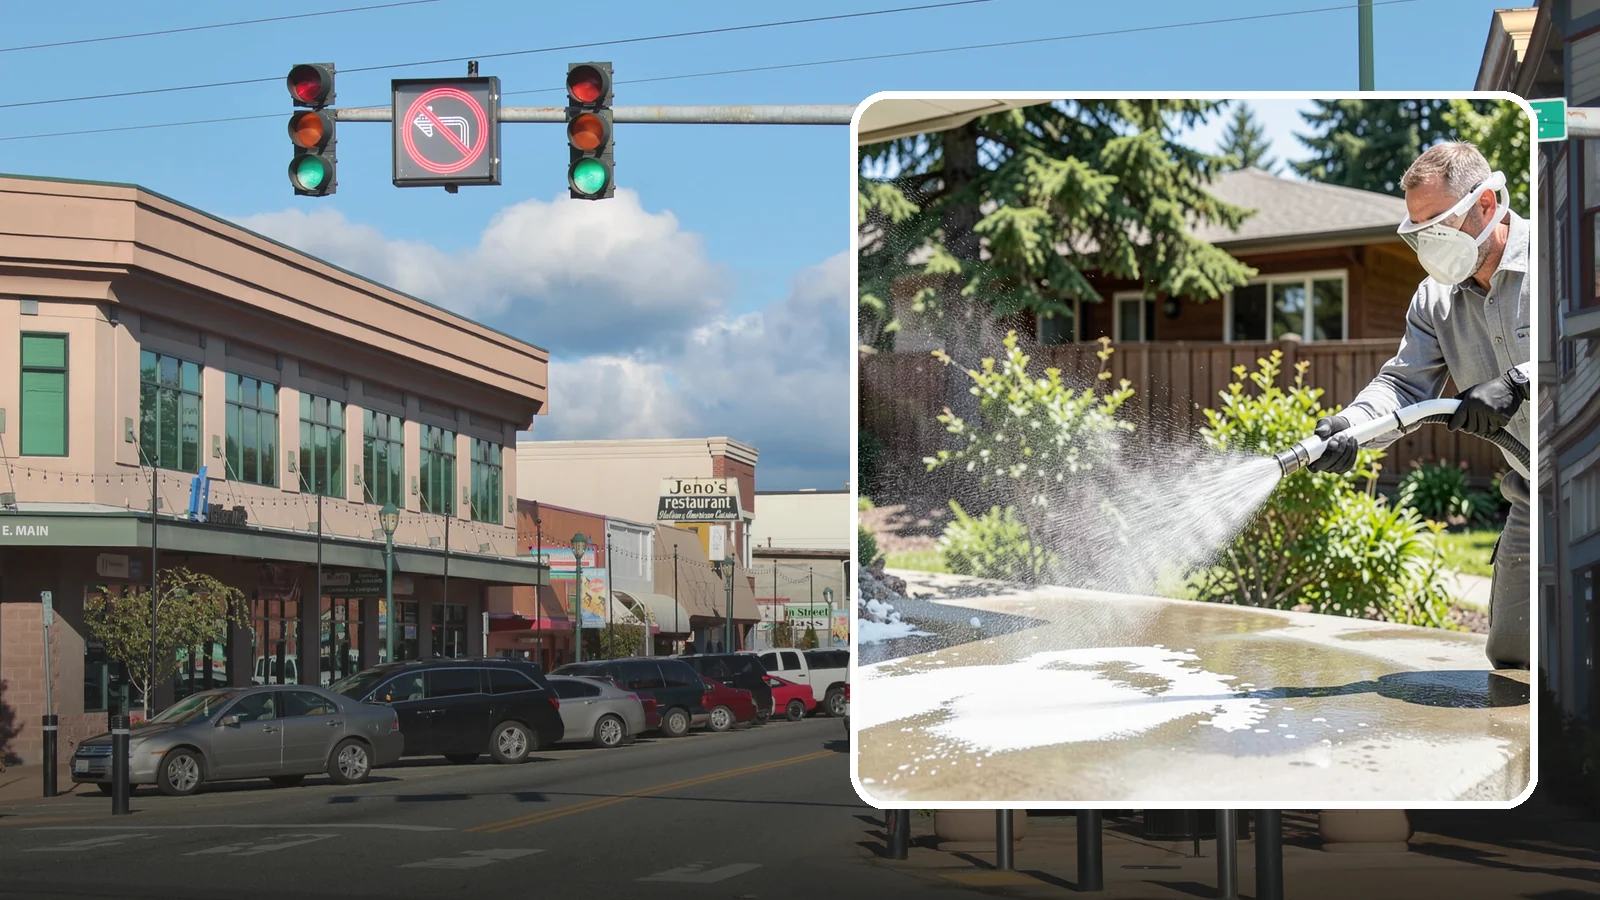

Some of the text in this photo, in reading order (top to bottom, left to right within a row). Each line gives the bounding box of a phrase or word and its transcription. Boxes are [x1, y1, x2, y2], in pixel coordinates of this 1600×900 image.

[669, 480, 727, 494] Jeno's
[665, 496, 731, 509] restaurant
[658, 509, 682, 519] Italian
[686, 509, 714, 519] American
[714, 509, 737, 519] Cuisine
[2, 525, 49, 536] E. MAIN
[797, 608, 828, 616] Street
